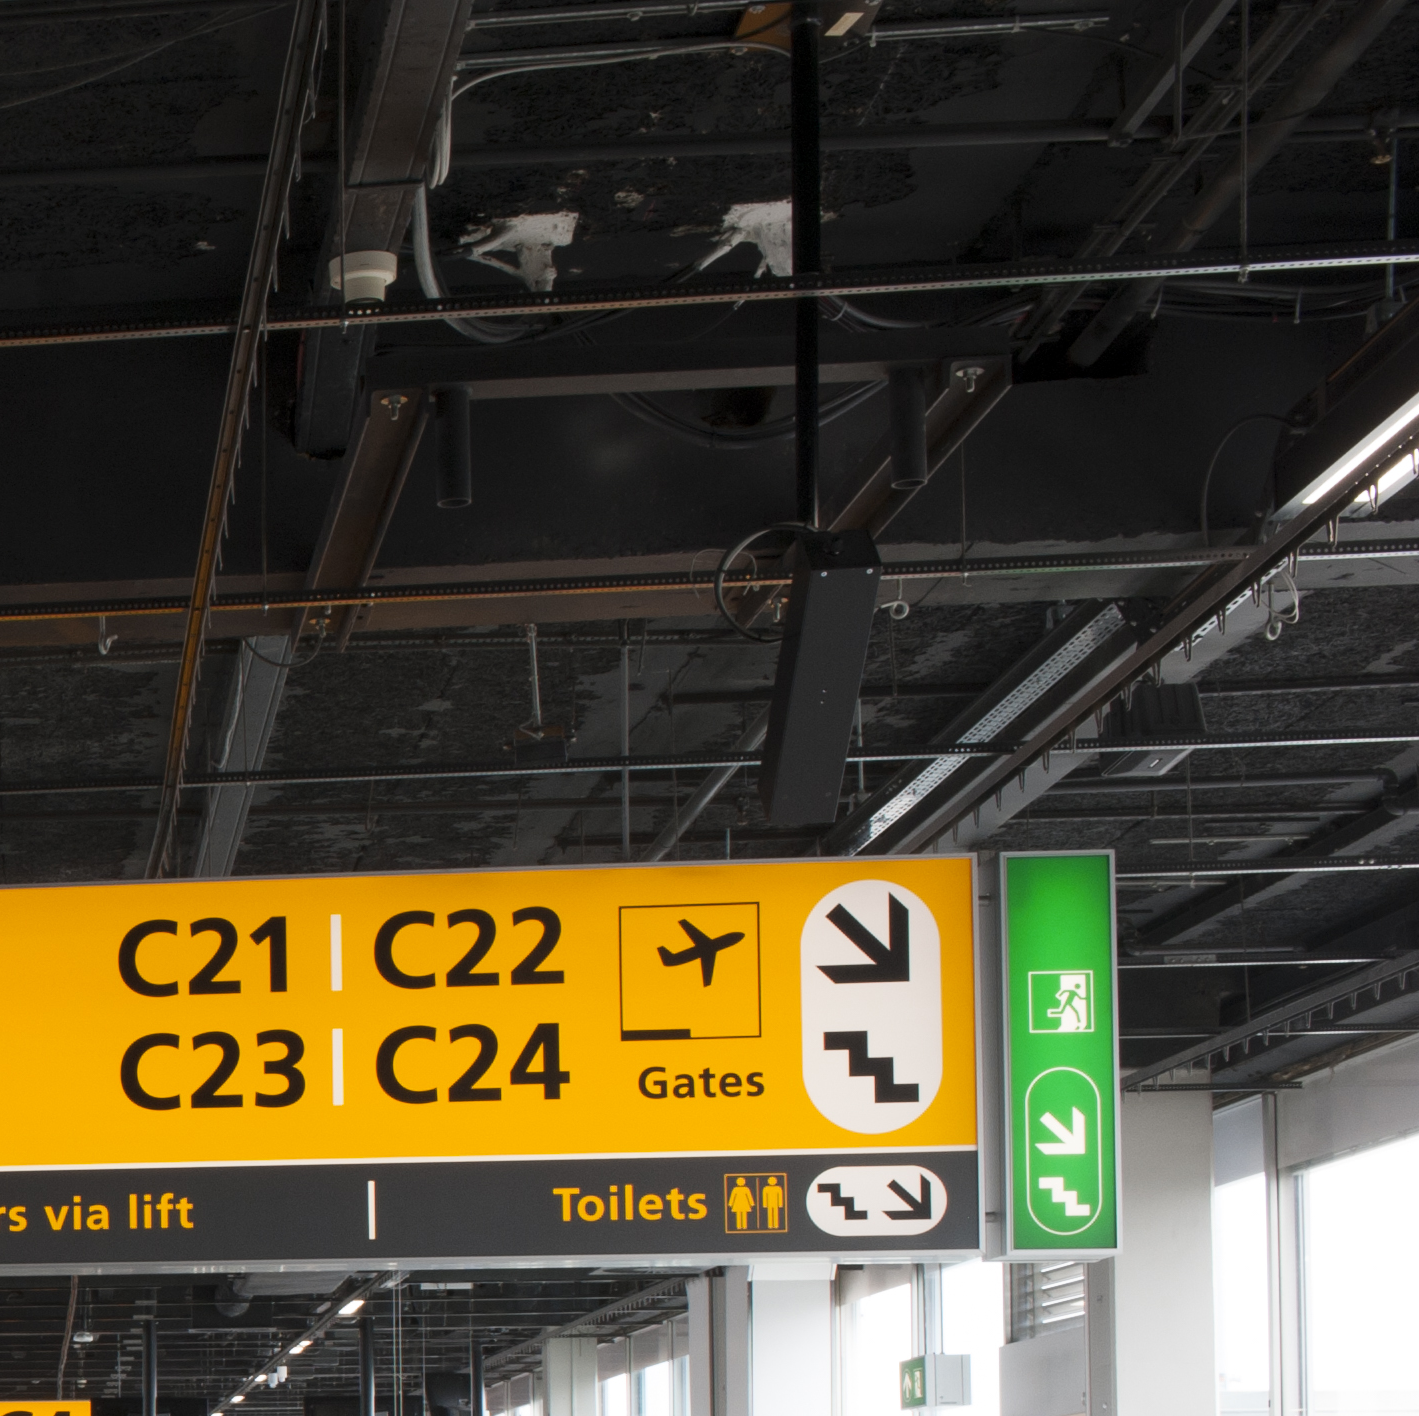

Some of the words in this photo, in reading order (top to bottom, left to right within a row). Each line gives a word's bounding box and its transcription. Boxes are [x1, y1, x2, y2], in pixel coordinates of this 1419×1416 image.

[118, 915, 288, 998] C21
[374, 906, 565, 990] C22
[120, 1029, 307, 1111] C23
[376, 1022, 571, 1105] C24
[638, 1066, 765, 1099] Gates
[43, 1195, 110, 1232] via
[128, 1192, 195, 1231] lift
[552, 1183, 709, 1223] Toilets
